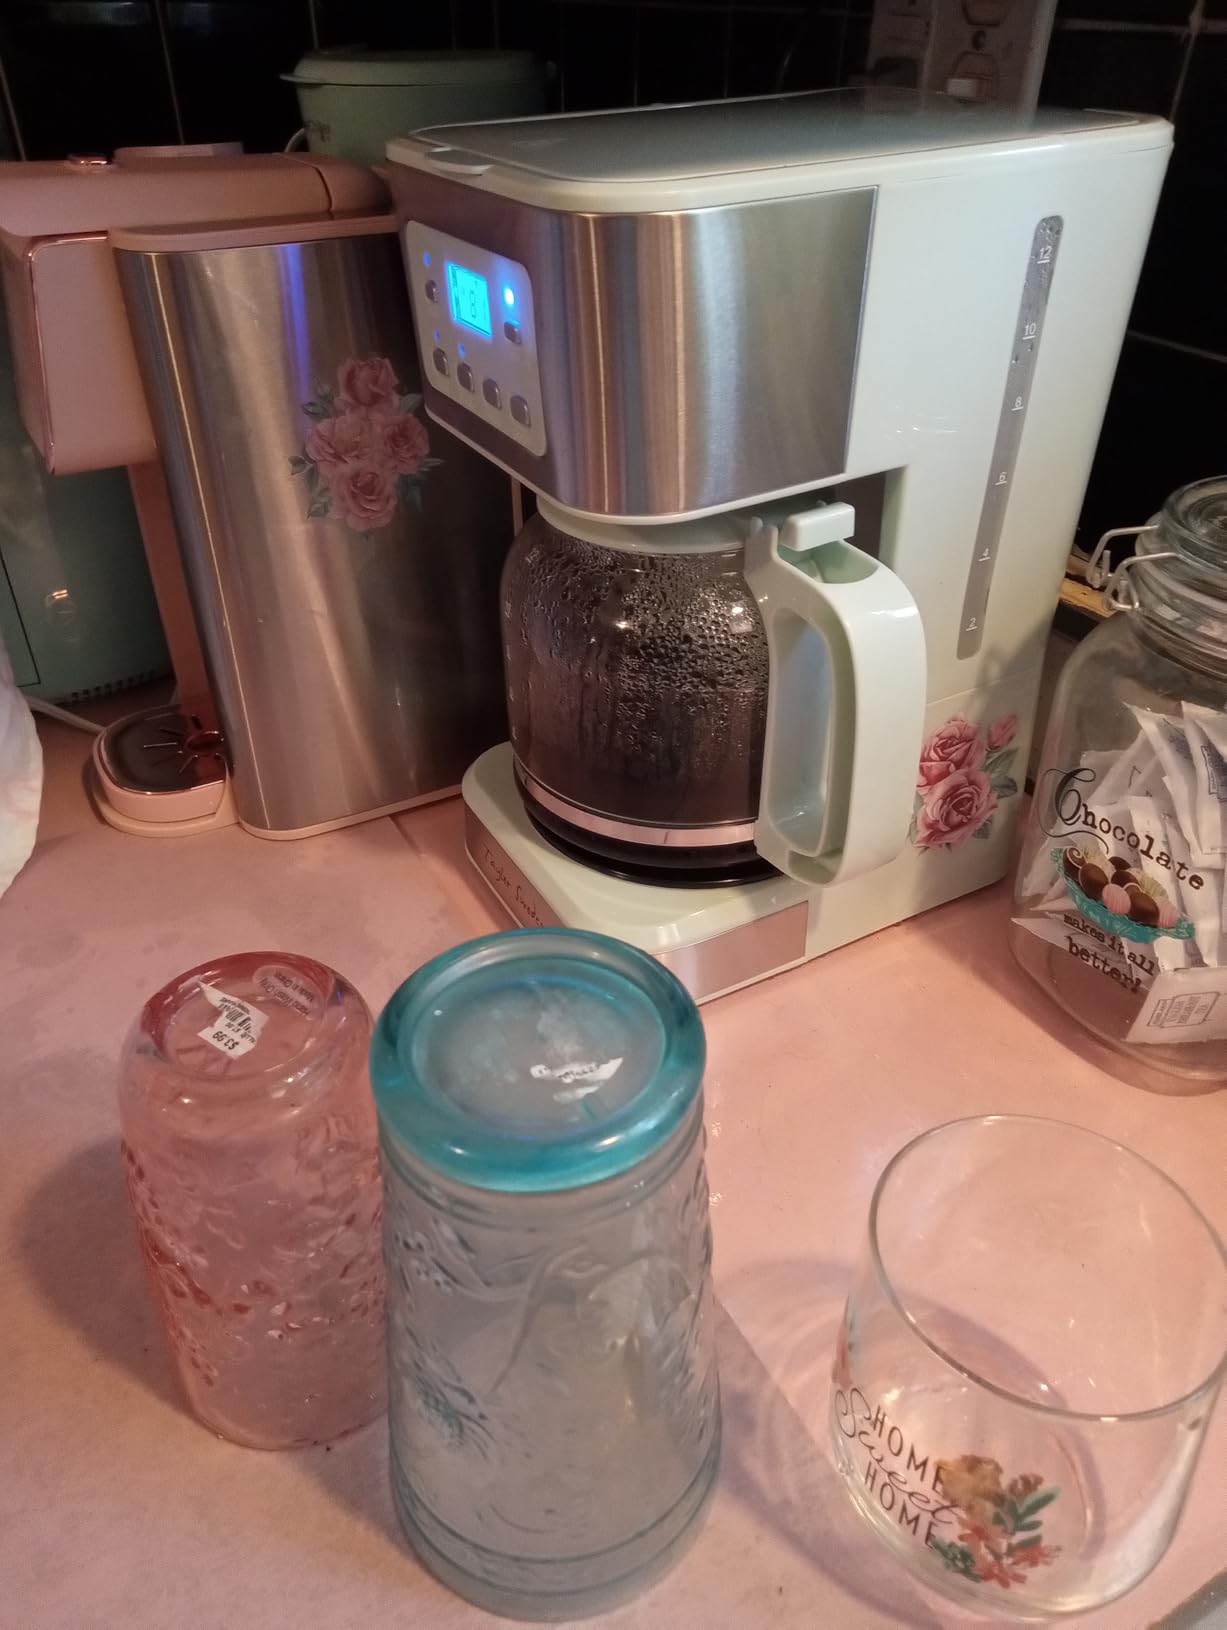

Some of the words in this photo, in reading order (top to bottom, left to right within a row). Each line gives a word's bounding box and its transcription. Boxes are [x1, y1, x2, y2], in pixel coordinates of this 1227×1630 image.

[1038, 245, 1053, 260] 12
[1023, 322, 1037, 336] 10
[1014, 396, 1023, 408] 8
[998, 470, 1008, 482] 6
[969, 616, 977, 628] 2
[1037, 767, 1206, 891] Chocolate
[1062, 912, 1105, 943] makes
[1107, 931, 1125, 954] it
[1126, 950, 1156, 977] all
[1066, 935, 1143, 994] better!
[833, 1386, 960, 1525] Sweet
[871, 1404, 945, 1496] HOME
[863, 1460, 938, 1551] HOME
